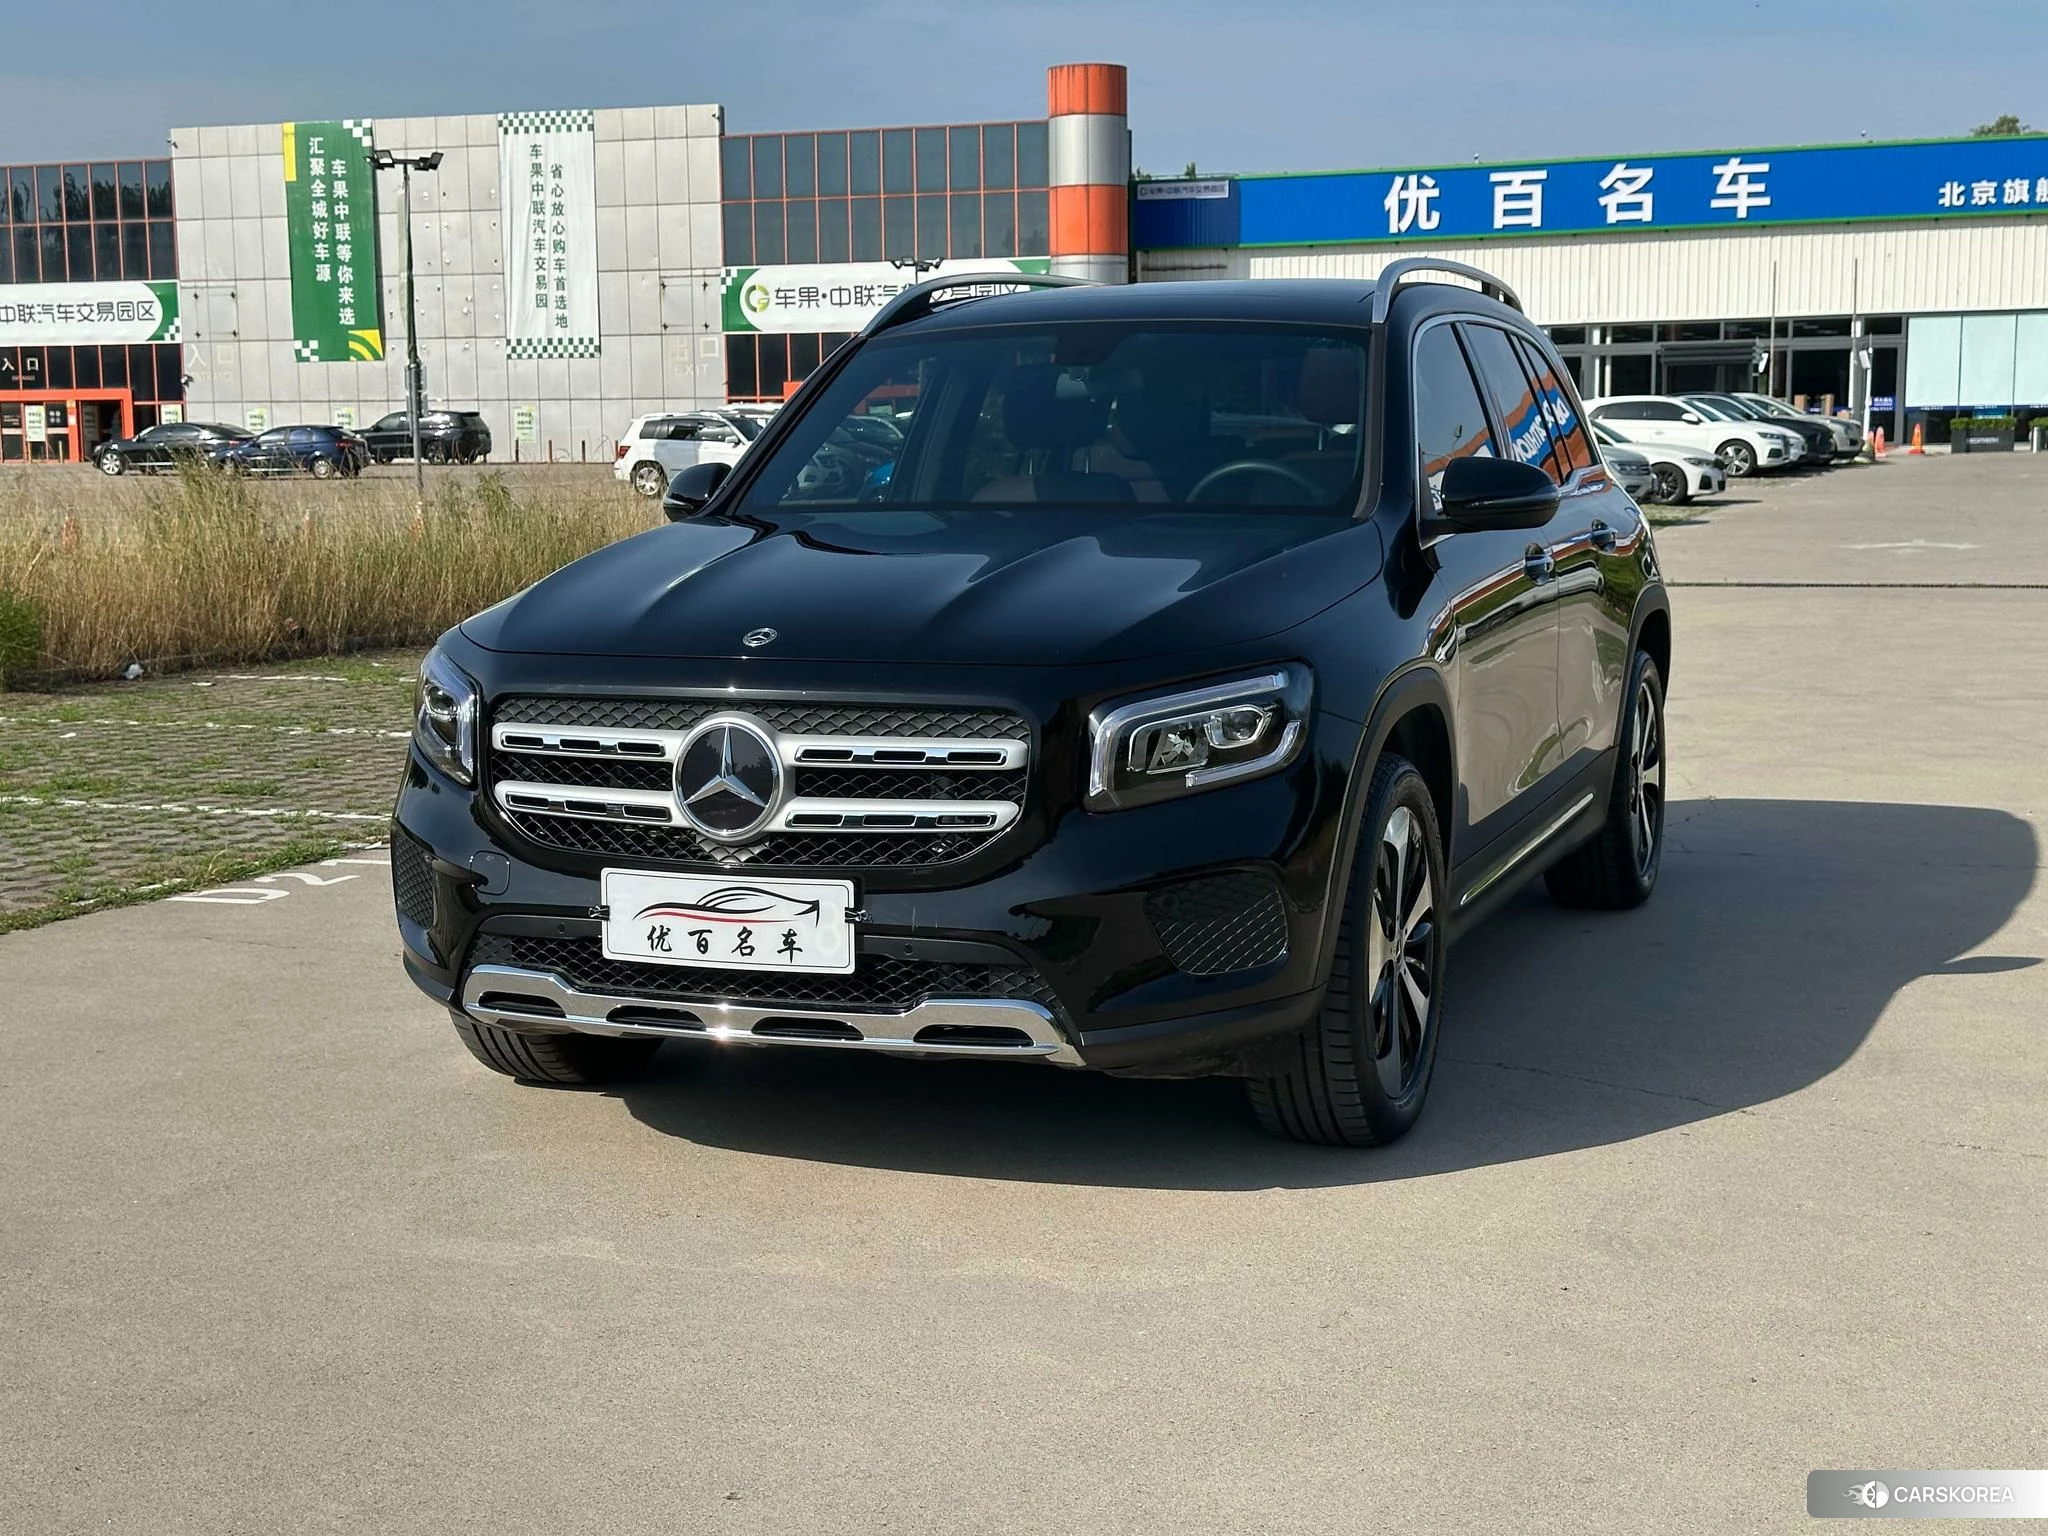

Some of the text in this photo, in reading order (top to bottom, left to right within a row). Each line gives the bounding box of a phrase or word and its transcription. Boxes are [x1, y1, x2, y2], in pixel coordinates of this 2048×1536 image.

[309, 137, 331, 282] 汇聚全城好车源
[529, 144, 548, 308] 车果中联汽车交易园
[1384, 157, 1771, 234] 优百名车
[331, 159, 355, 325] 车果中联等你来选
[550, 163, 568, 328] 省心放心购车首选地
[0, 301, 156, 324] 中联汽车交易园区
[2, 358, 39, 371] 入口
[187, 344, 234, 368] 入口
[647, 925, 803, 963] 优百名车
